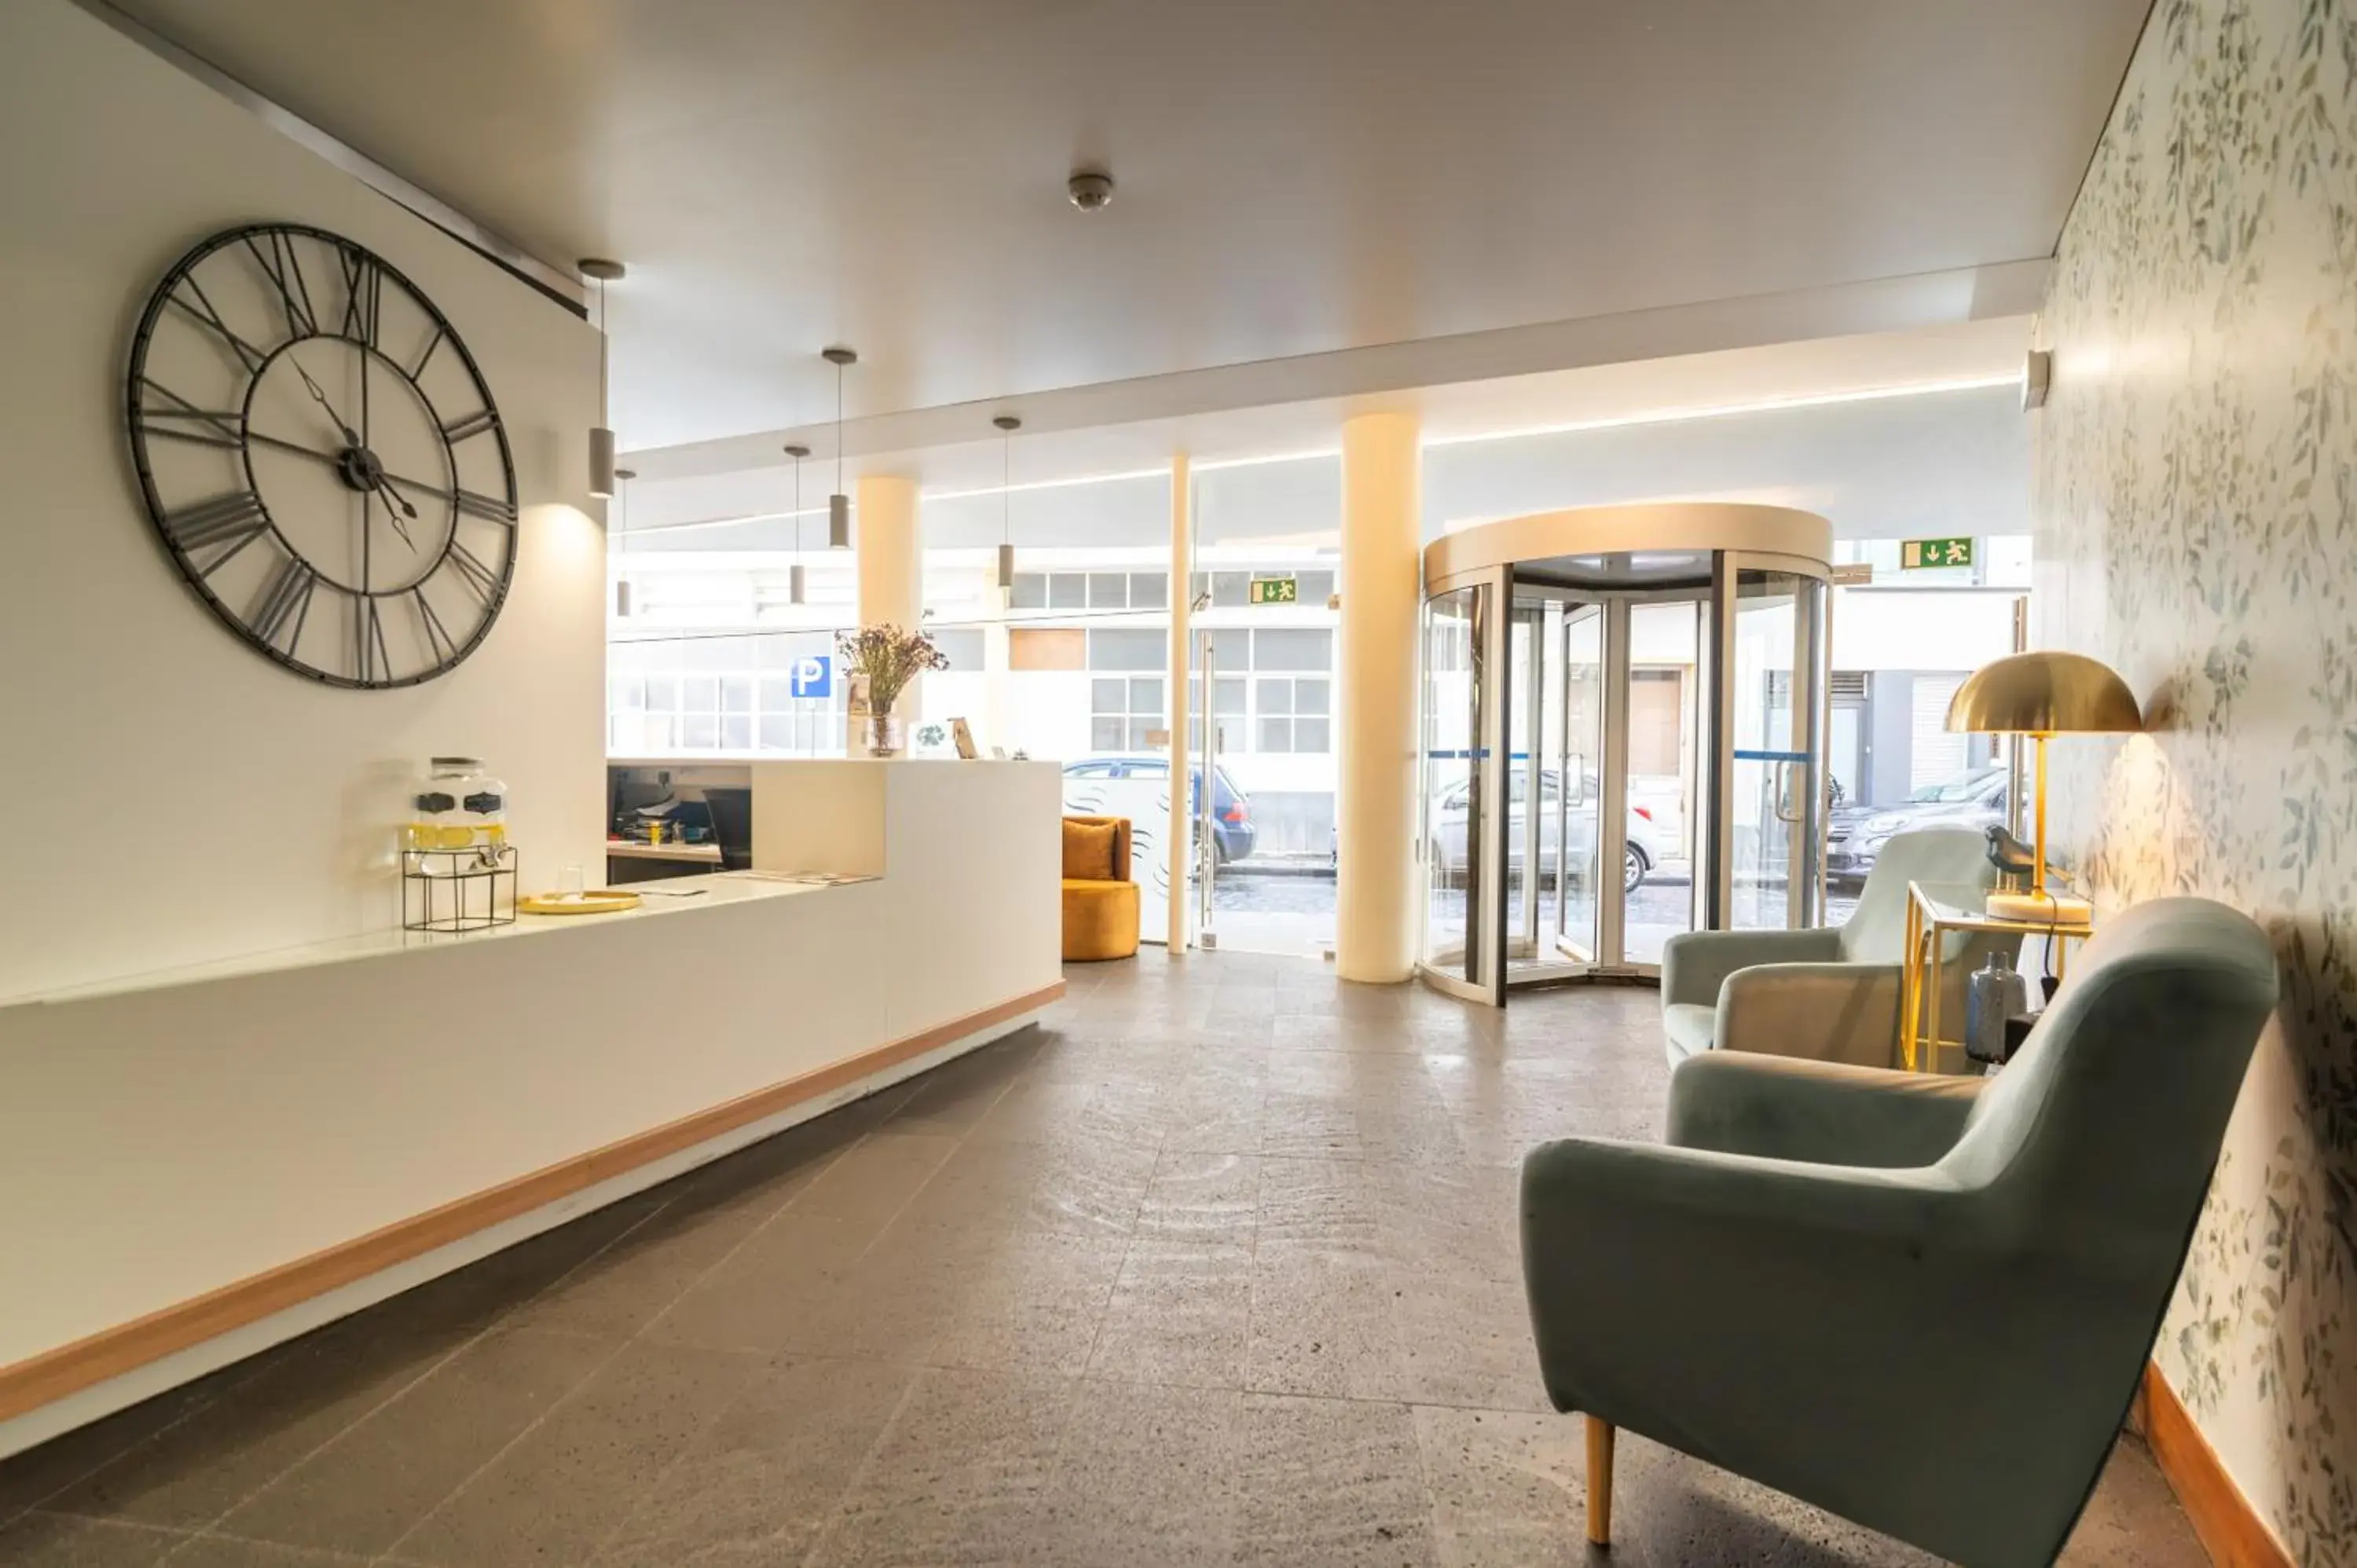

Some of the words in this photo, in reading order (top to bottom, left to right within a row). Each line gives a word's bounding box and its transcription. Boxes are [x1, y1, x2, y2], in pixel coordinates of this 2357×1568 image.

[165, 270, 268, 376] X
[240, 226, 318, 339] XI
[337, 242, 383, 351] XII
[410, 323, 446, 383] I
[137, 374, 247, 449] IX
[442, 408, 499, 445] II
[163, 489, 272, 581] VIII
[455, 487, 515, 527] III
[251, 555, 317, 659] VII
[355, 591, 392, 685] VI
[414, 586, 459, 667] V
[798, 658, 823, 695] P
